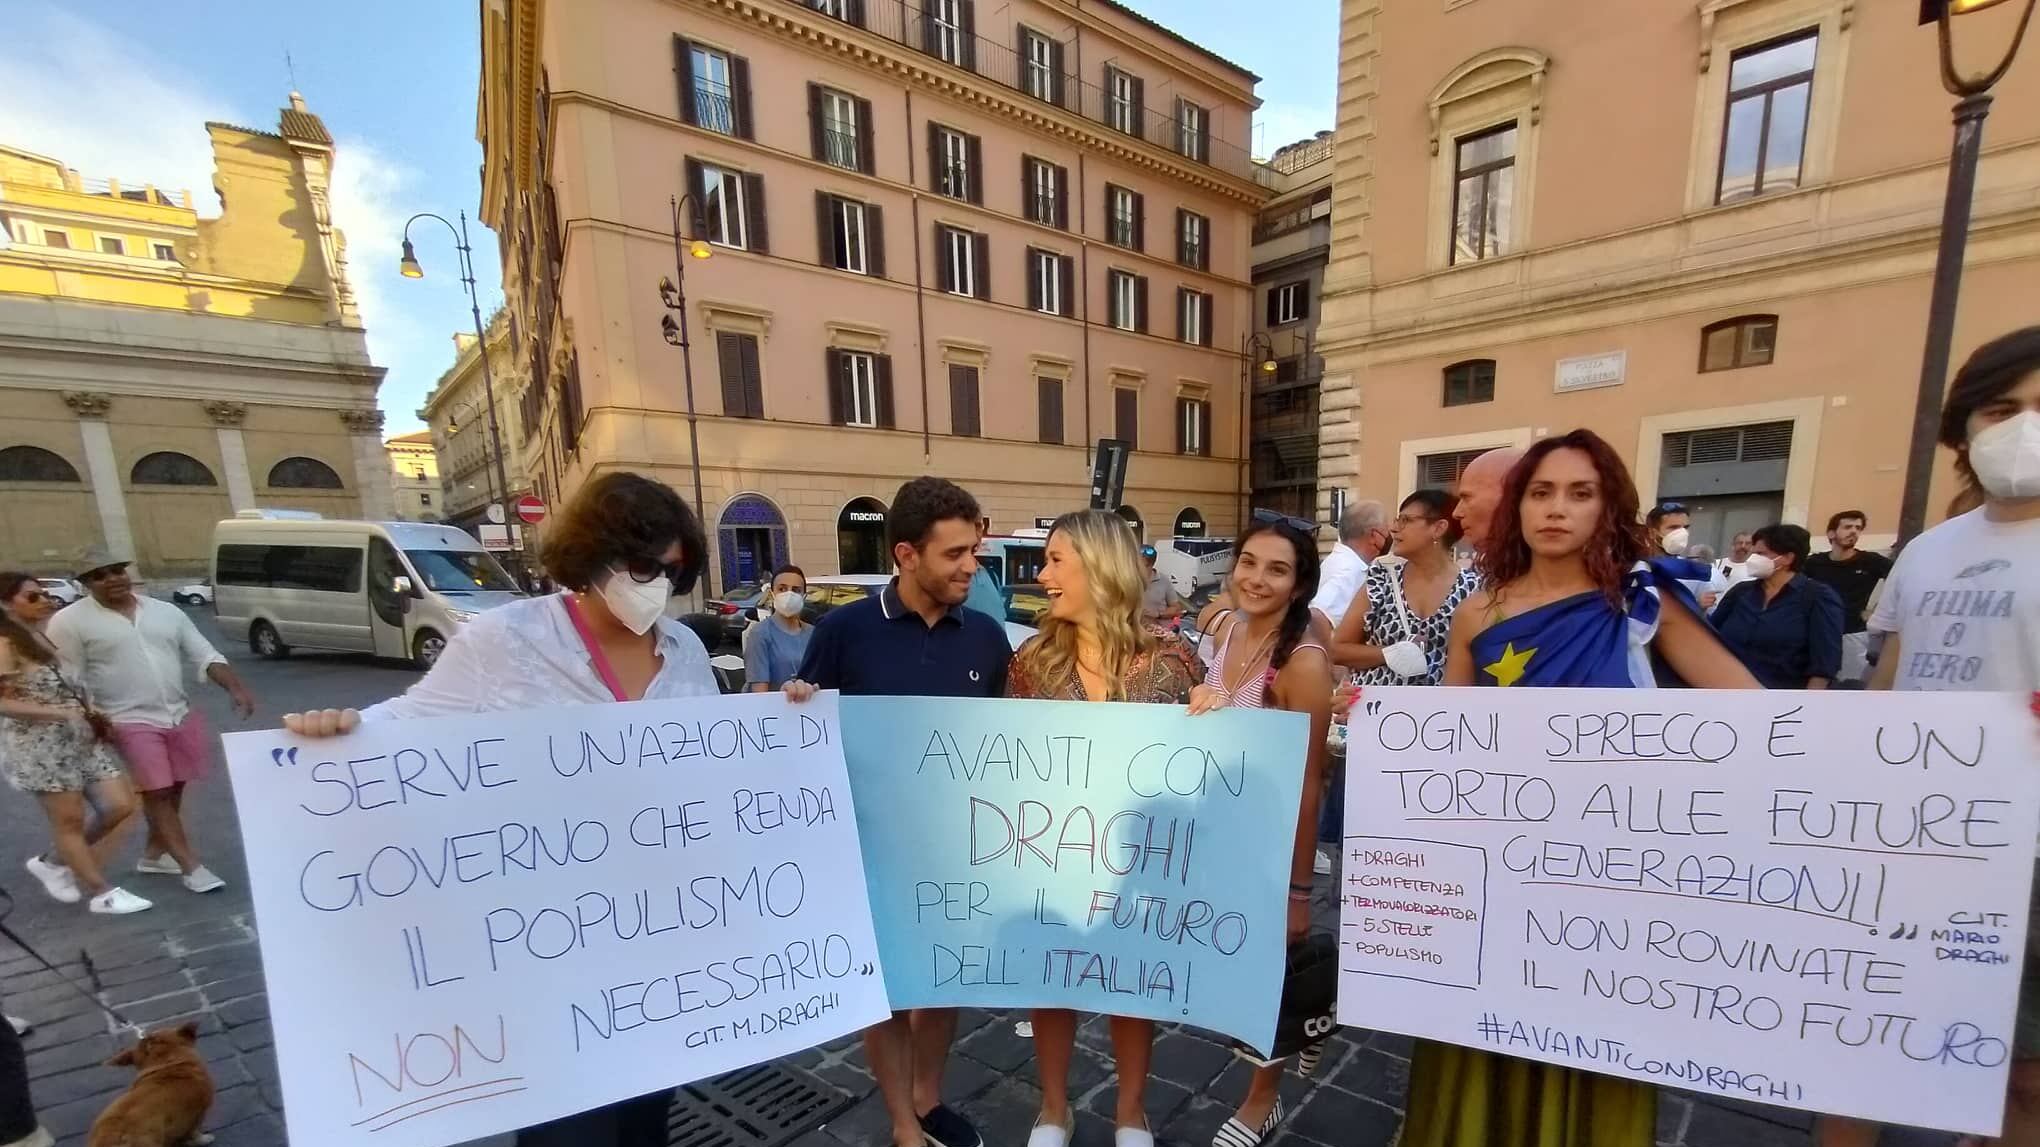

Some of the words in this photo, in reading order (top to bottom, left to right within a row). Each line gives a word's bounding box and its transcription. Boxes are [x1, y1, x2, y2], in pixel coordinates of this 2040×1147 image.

[850, 512, 884, 521] macron
[1915, 590, 2016, 617] PIUMA
[549, 714, 787, 779] UN'AZIONE
[800, 714, 829, 752] DI
[916, 729, 1093, 789] AVANTI
[1127, 743, 1246, 798] CON
[1545, 712, 1738, 762] SPRECO
[1875, 721, 1985, 770] UN
[969, 796, 1196, 886] DRAGHI
[1380, 769, 1556, 821] TORTO
[1580, 783, 1728, 836] ALLE
[1768, 789, 2011, 850] FUTURE
[300, 818, 609, 911] GOVERNO
[629, 800, 712, 850] CHE
[733, 786, 837, 836] RENDA
[402, 926, 464, 990] IL
[484, 861, 805, 971] POPULISMO
[915, 880, 993, 924] PER
[1033, 887, 1068, 926] IL
[1086, 890, 1249, 956] FUTURO
[1525, 908, 1630, 956] NON
[1645, 919, 1907, 996] ROVINATE
[1930, 929, 2001, 944] MARIO
[1948, 911, 2009, 927] CIT.
[1356, 941, 1443, 965] POPULISMO
[1935, 946, 2010, 966] DRAGHI
[685, 1023, 725, 1050] CIT.
[1523, 959, 1560, 992] IL
[1582, 968, 1783, 1032] NOSTRO
[1800, 1002, 2010, 1070] FUTURO
[349, 1015, 506, 1107] NON
[1476, 1012, 1804, 1102] #AVANTICONDRAGHI
